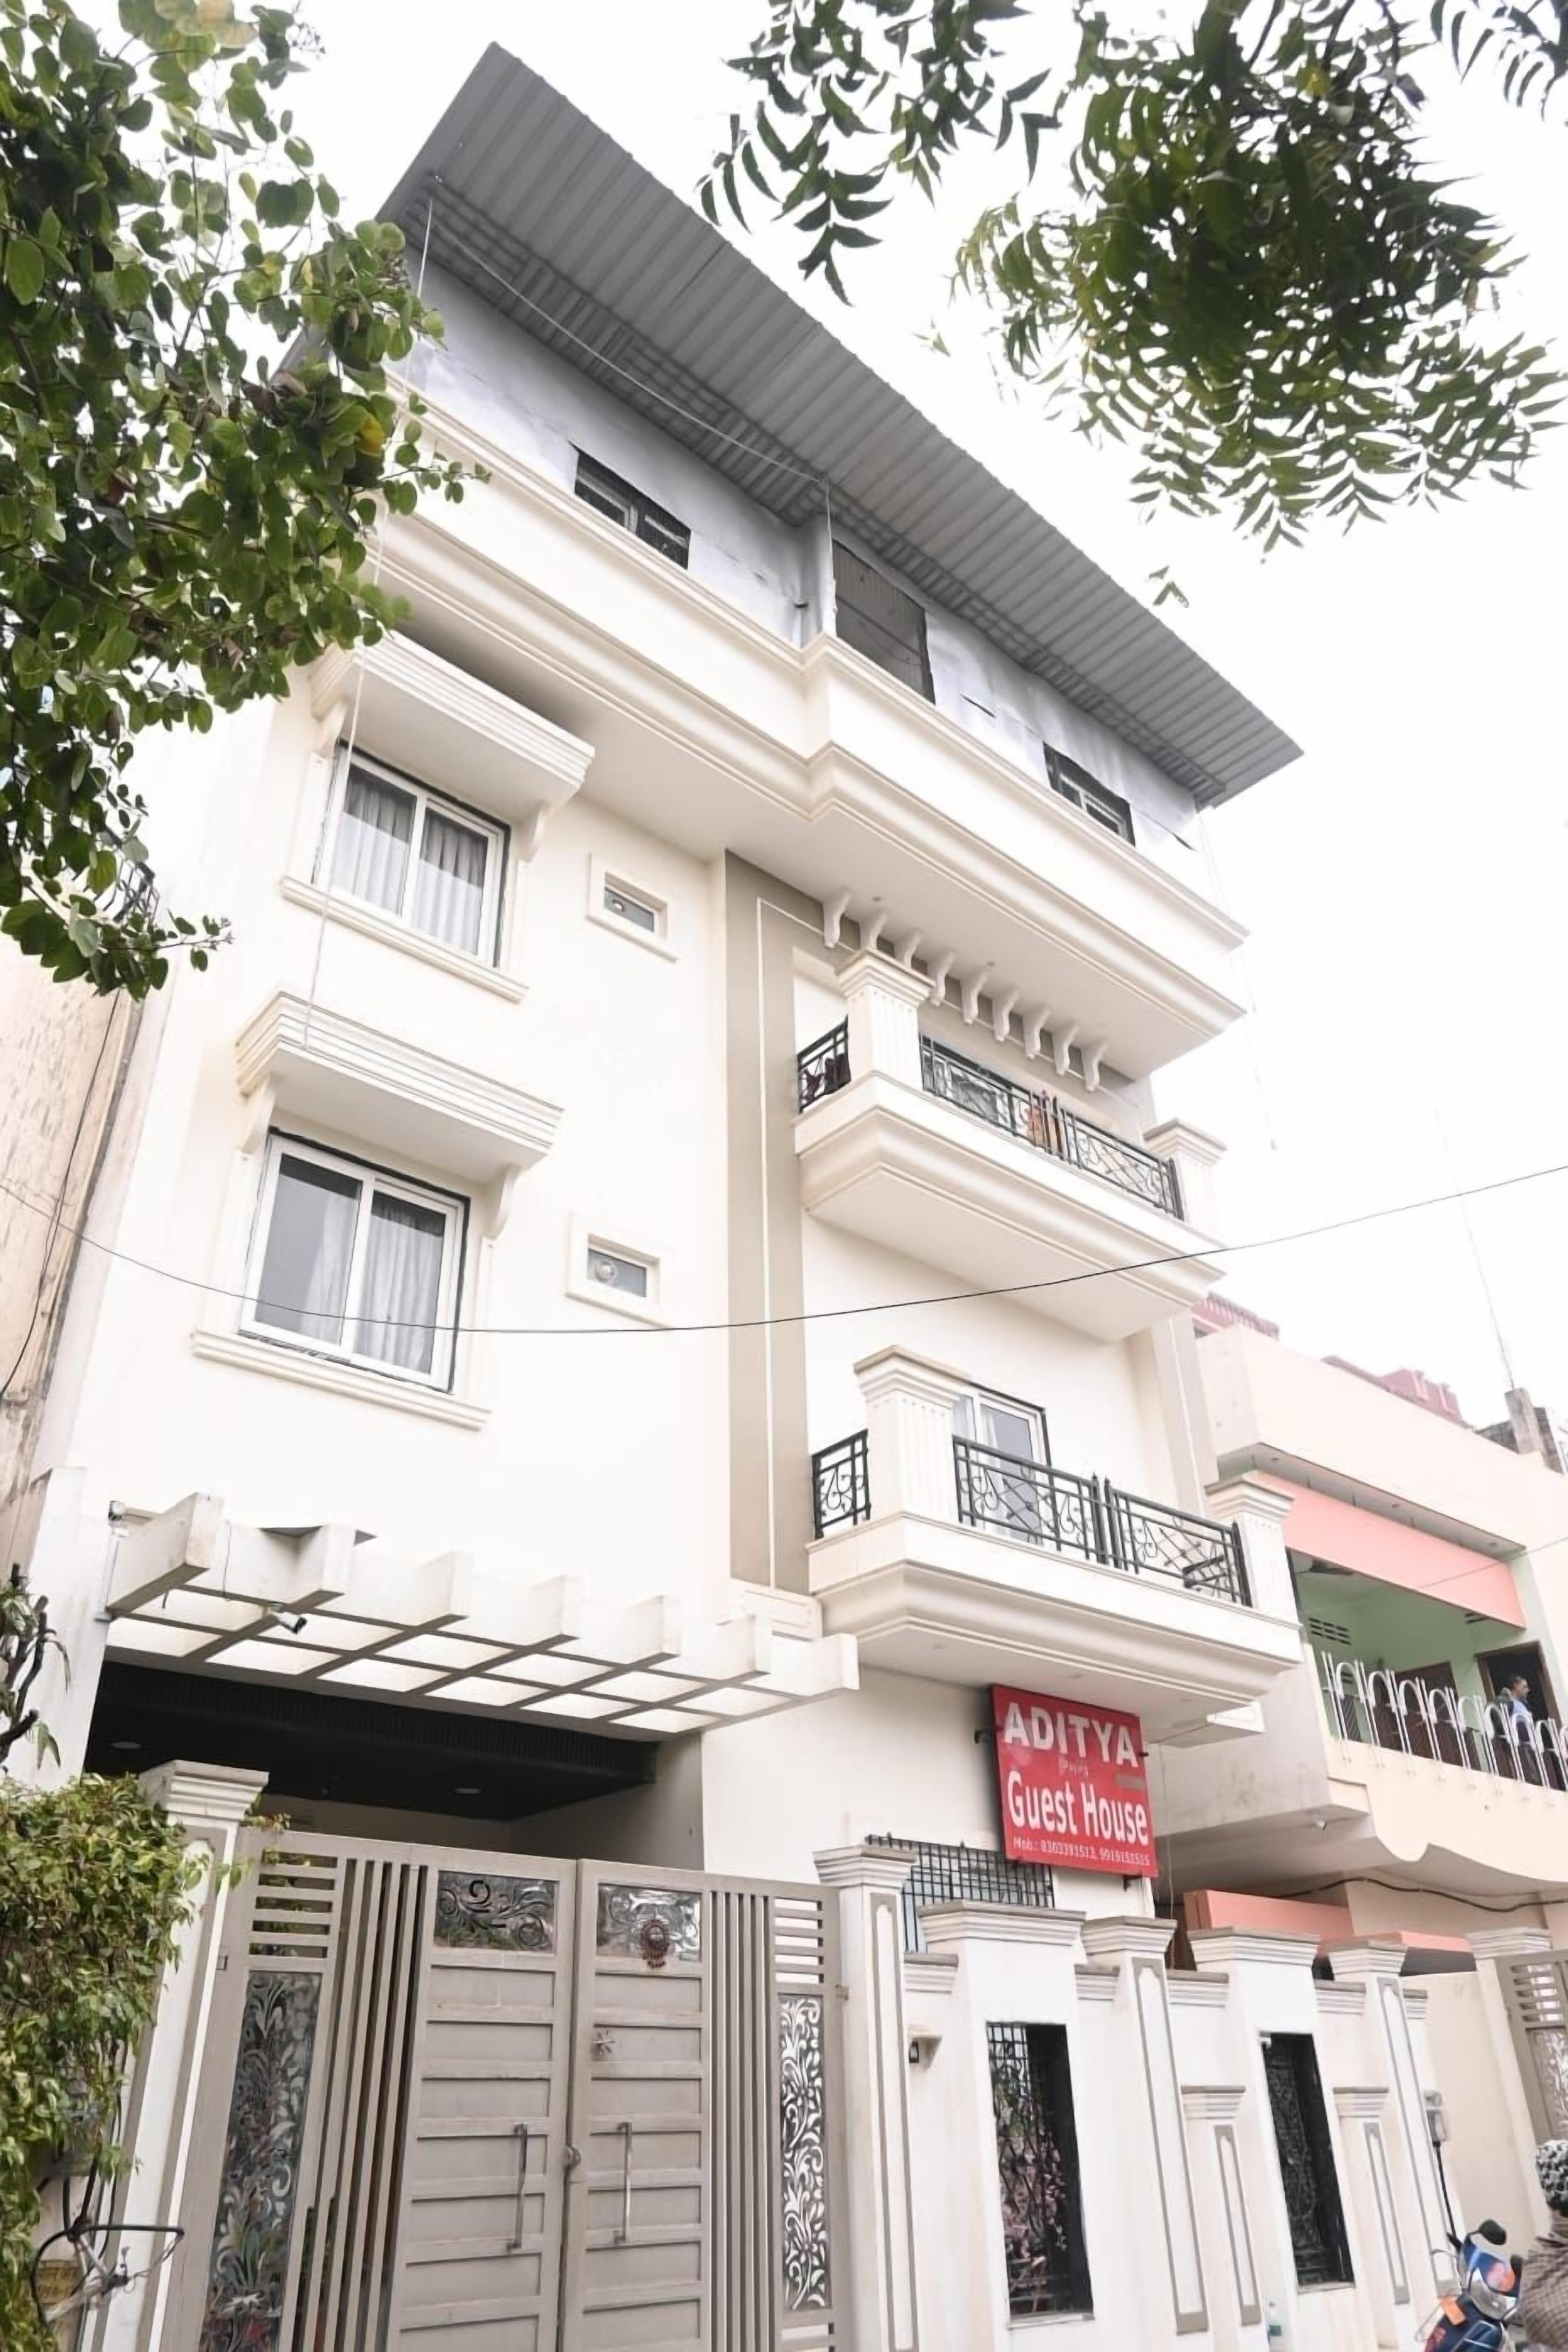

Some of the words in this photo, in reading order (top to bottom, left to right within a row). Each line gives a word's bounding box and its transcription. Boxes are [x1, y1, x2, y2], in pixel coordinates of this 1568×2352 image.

[1003, 1702, 1138, 1767] ADITYA
[1008, 1770, 1077, 1835] Guest
[1081, 1783, 1148, 1845] House
